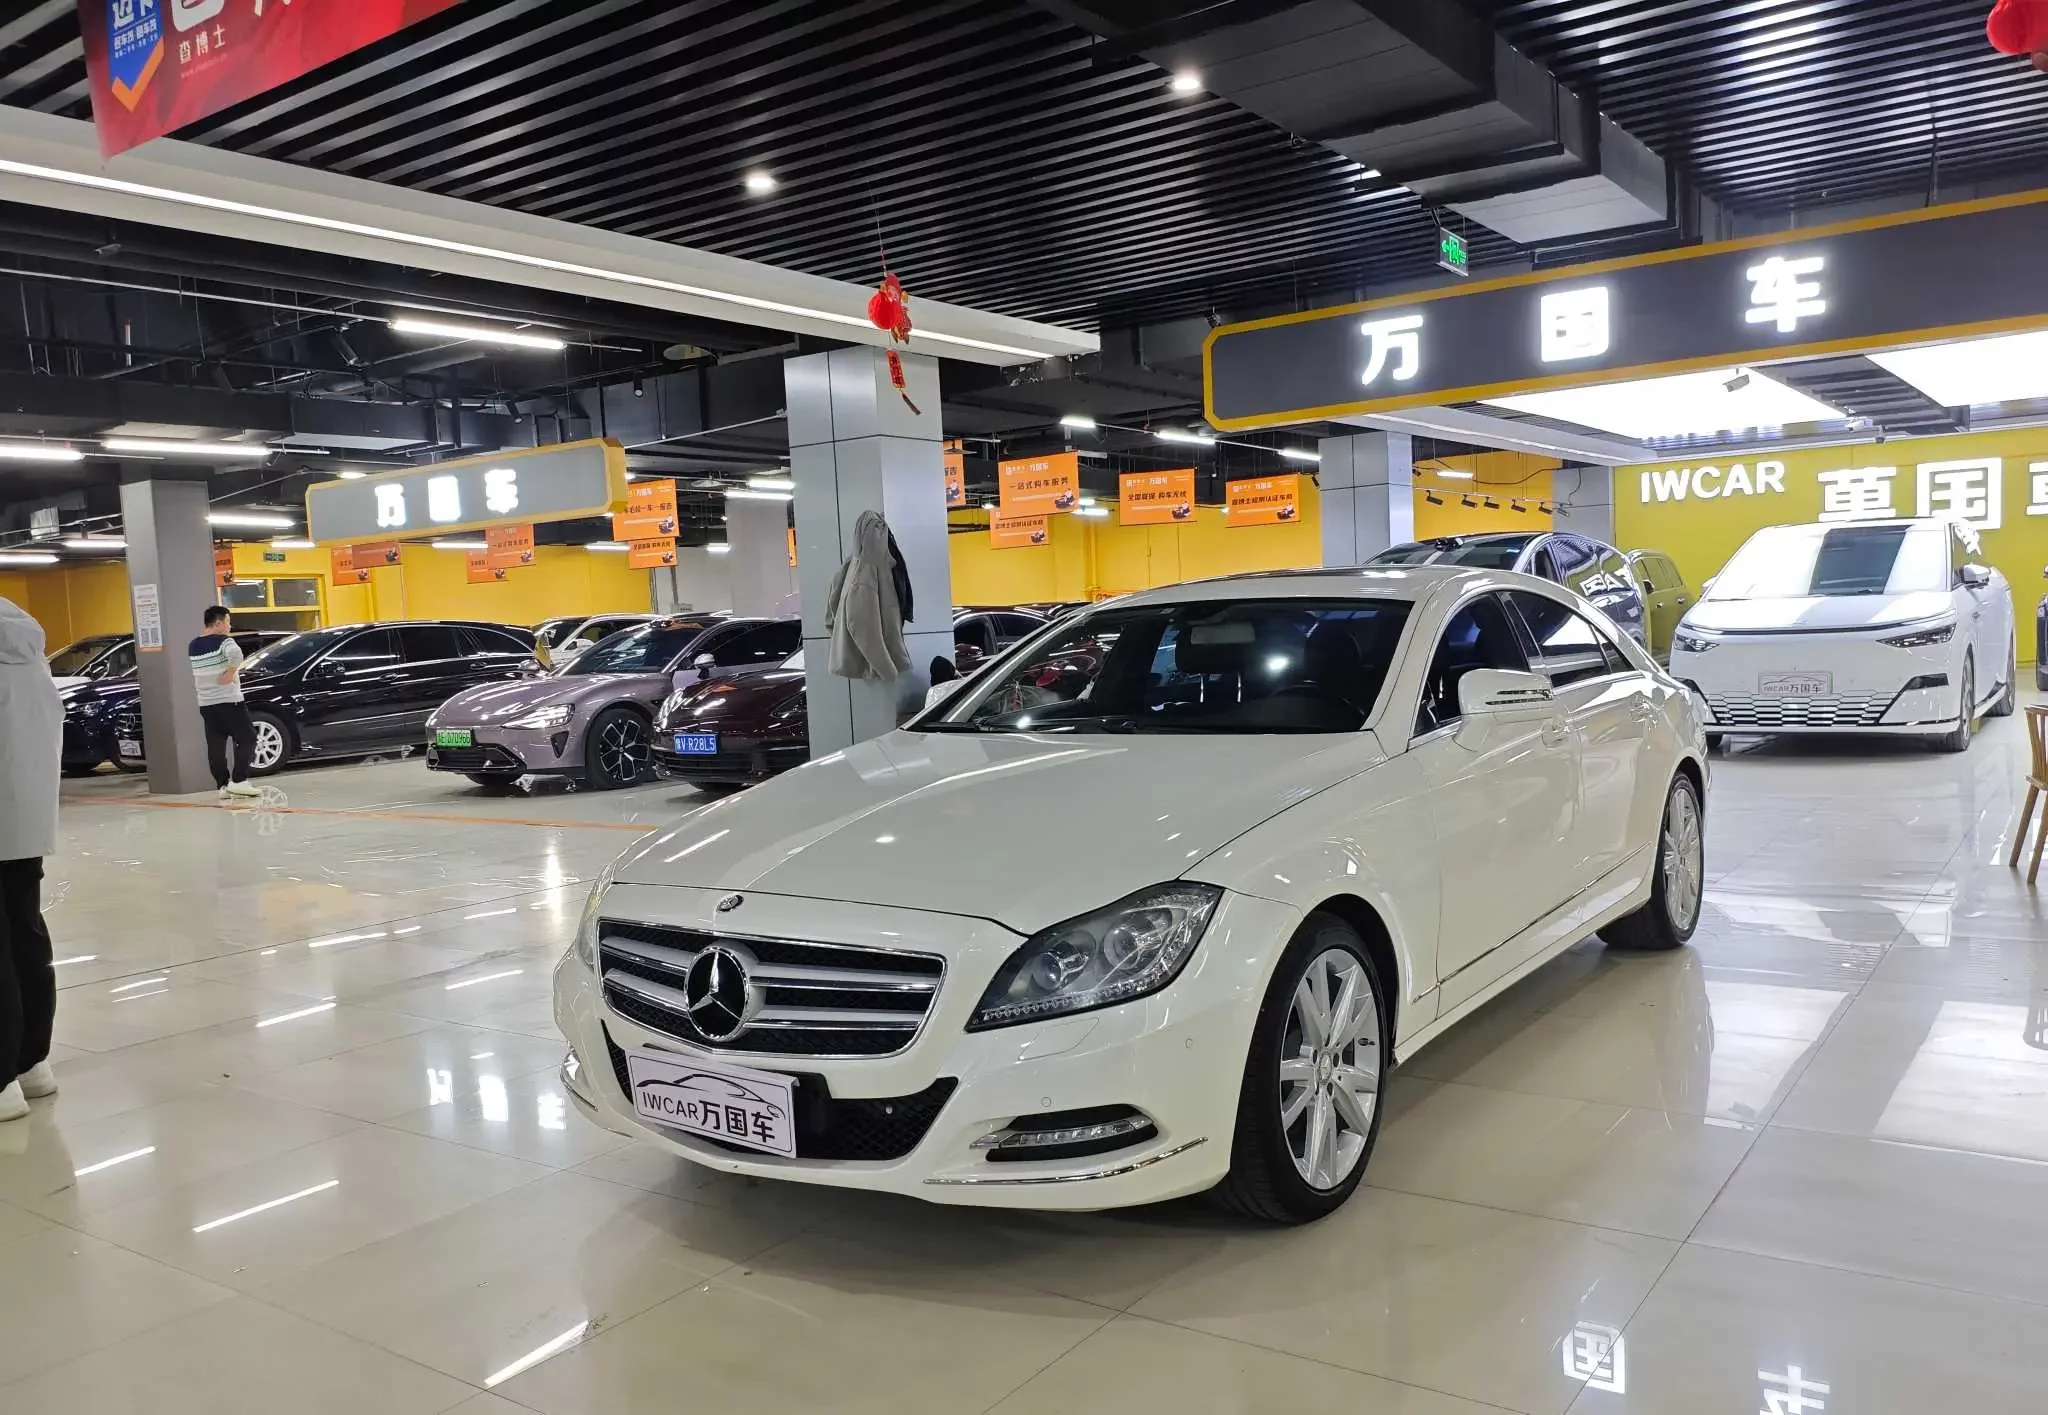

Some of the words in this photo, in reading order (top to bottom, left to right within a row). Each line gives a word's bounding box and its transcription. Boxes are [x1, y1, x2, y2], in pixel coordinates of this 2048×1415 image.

[179, 24, 226, 64] 查博士
[1361, 255, 1827, 385] 万国车
[1640, 460, 1786, 504] IWCAR
[642, 1091, 776, 1143] IWCAR万国车
